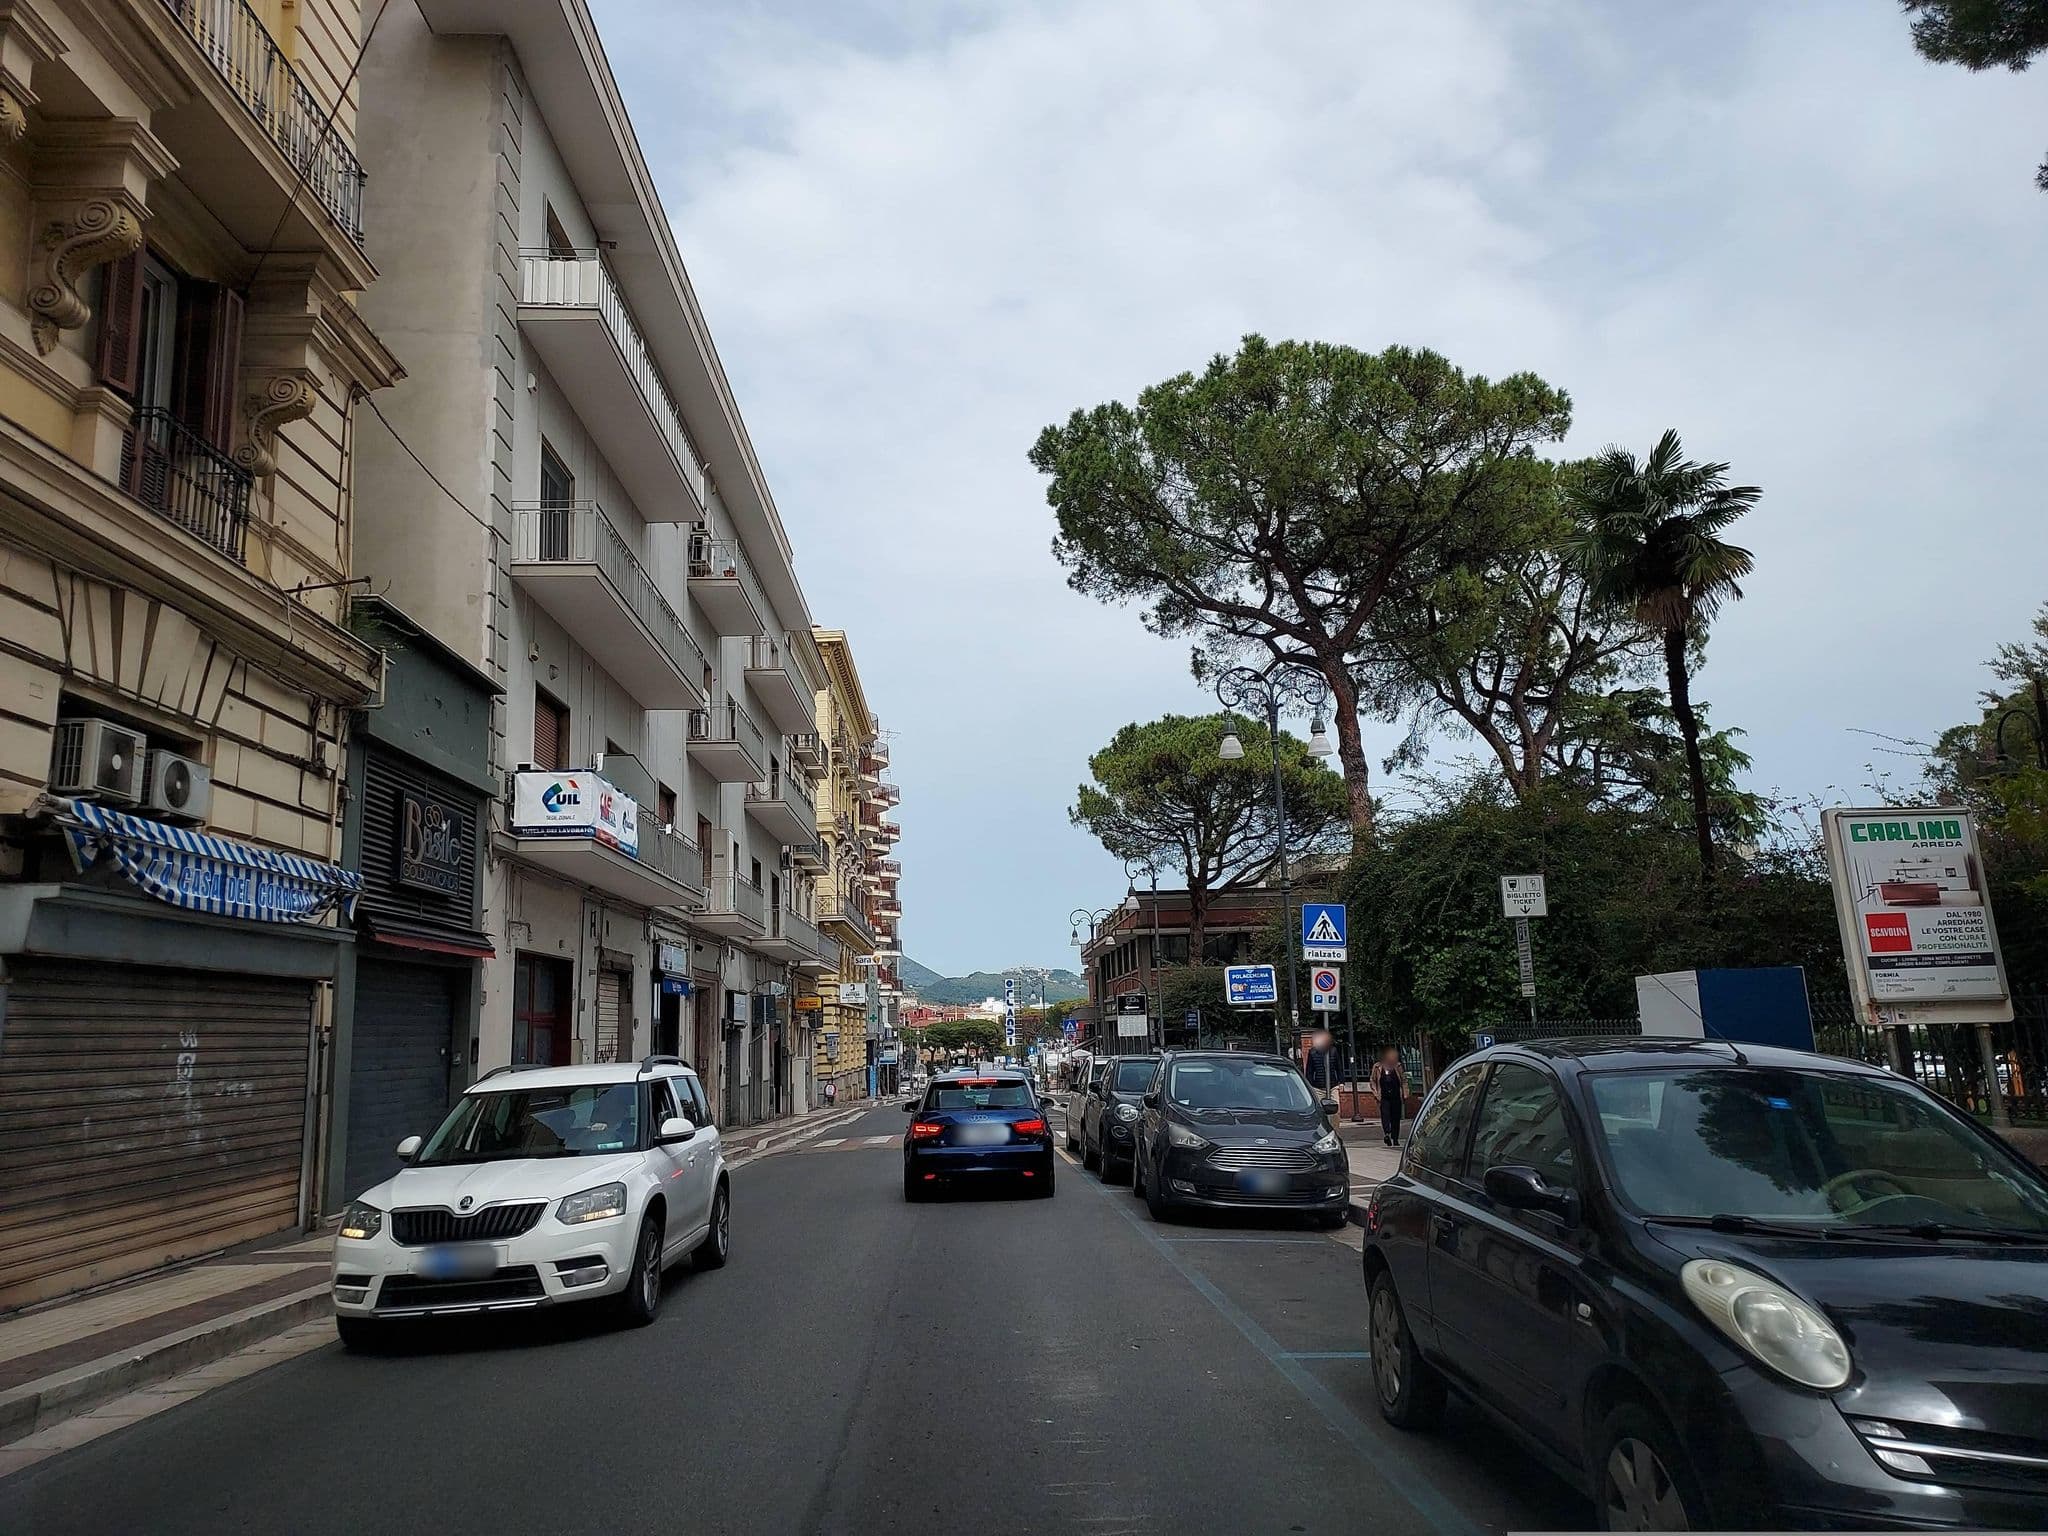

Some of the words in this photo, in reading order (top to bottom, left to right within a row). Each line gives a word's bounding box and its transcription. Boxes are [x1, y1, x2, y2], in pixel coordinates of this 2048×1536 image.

[556, 794, 580, 805] UIL
[403, 798, 460, 866] Basile
[1850, 820, 1962, 842] CARLINO
[146, 859, 173, 886] LA
[180, 866, 222, 901] CASA
[228, 877, 251, 905] DEL
[1870, 927, 1908, 937] SCAVOLINI
[1308, 950, 1341, 958] rialzato
